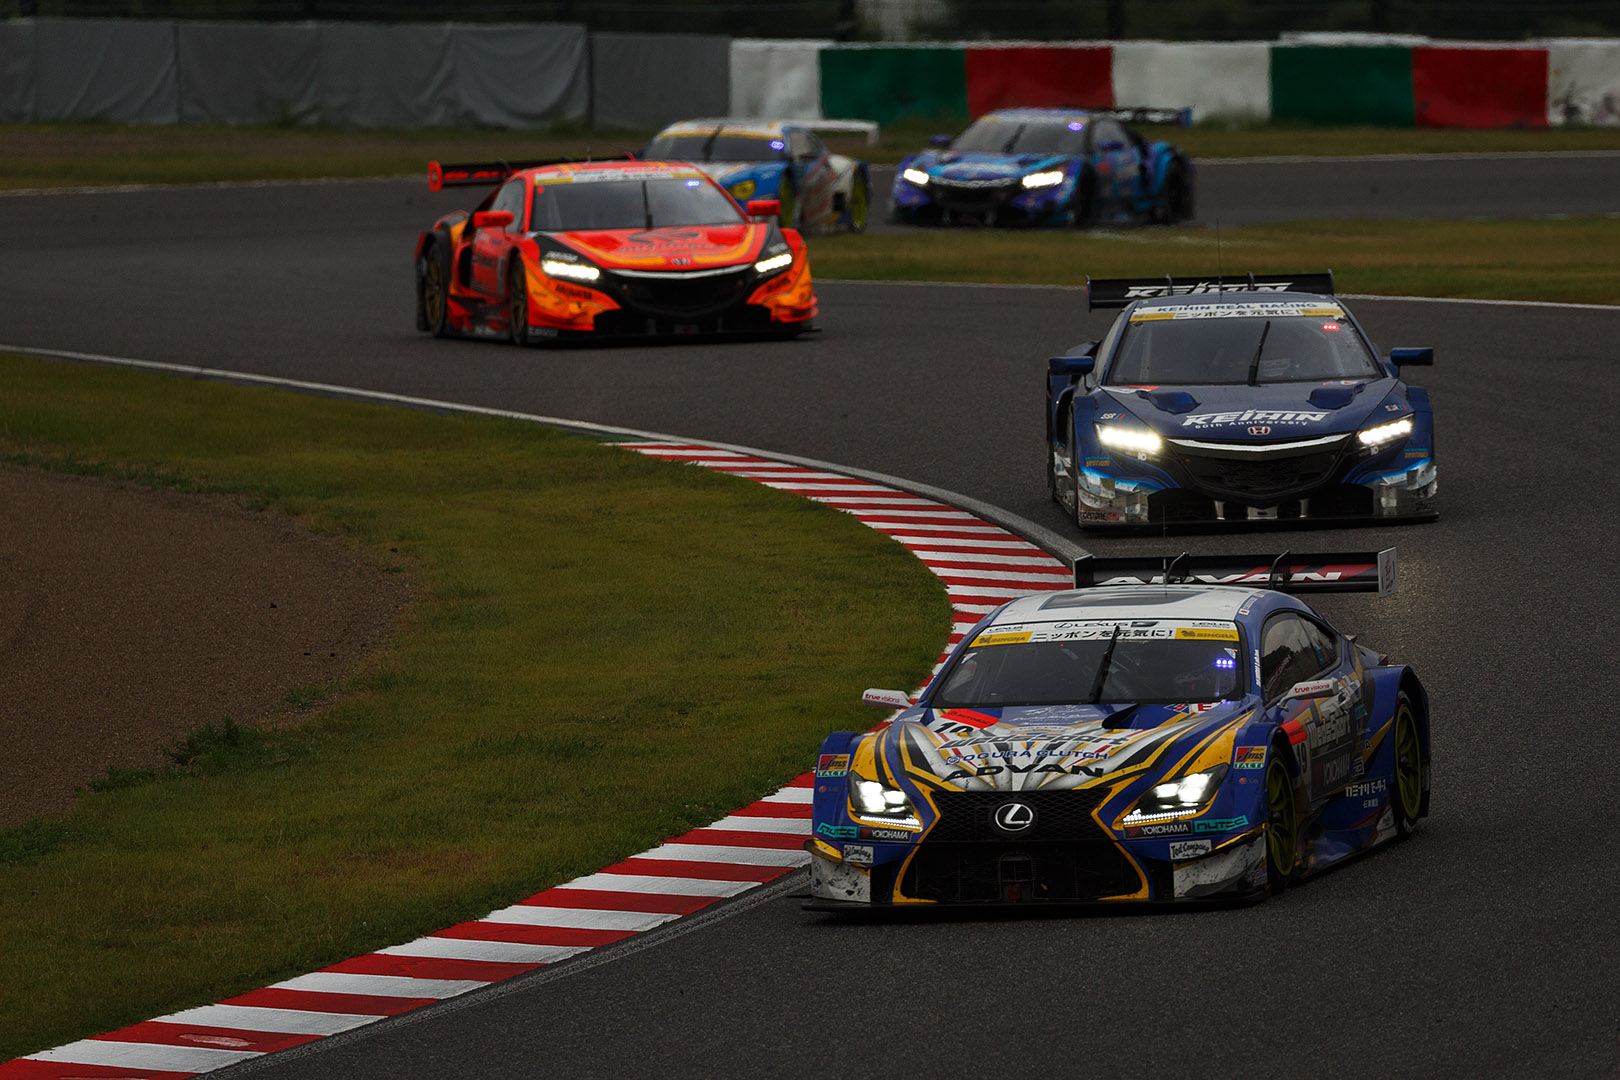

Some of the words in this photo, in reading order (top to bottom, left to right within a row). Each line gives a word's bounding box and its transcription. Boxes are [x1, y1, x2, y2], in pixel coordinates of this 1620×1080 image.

[1182, 409, 1330, 426] KEIHIN
[963, 751, 1033, 761] OGURA
[1037, 751, 1108, 760] CLUTCH
[941, 764, 1104, 783] ADVAN
[871, 830, 909, 839] YOKOHAMA
[1141, 824, 1189, 835] YOKOHAMA
